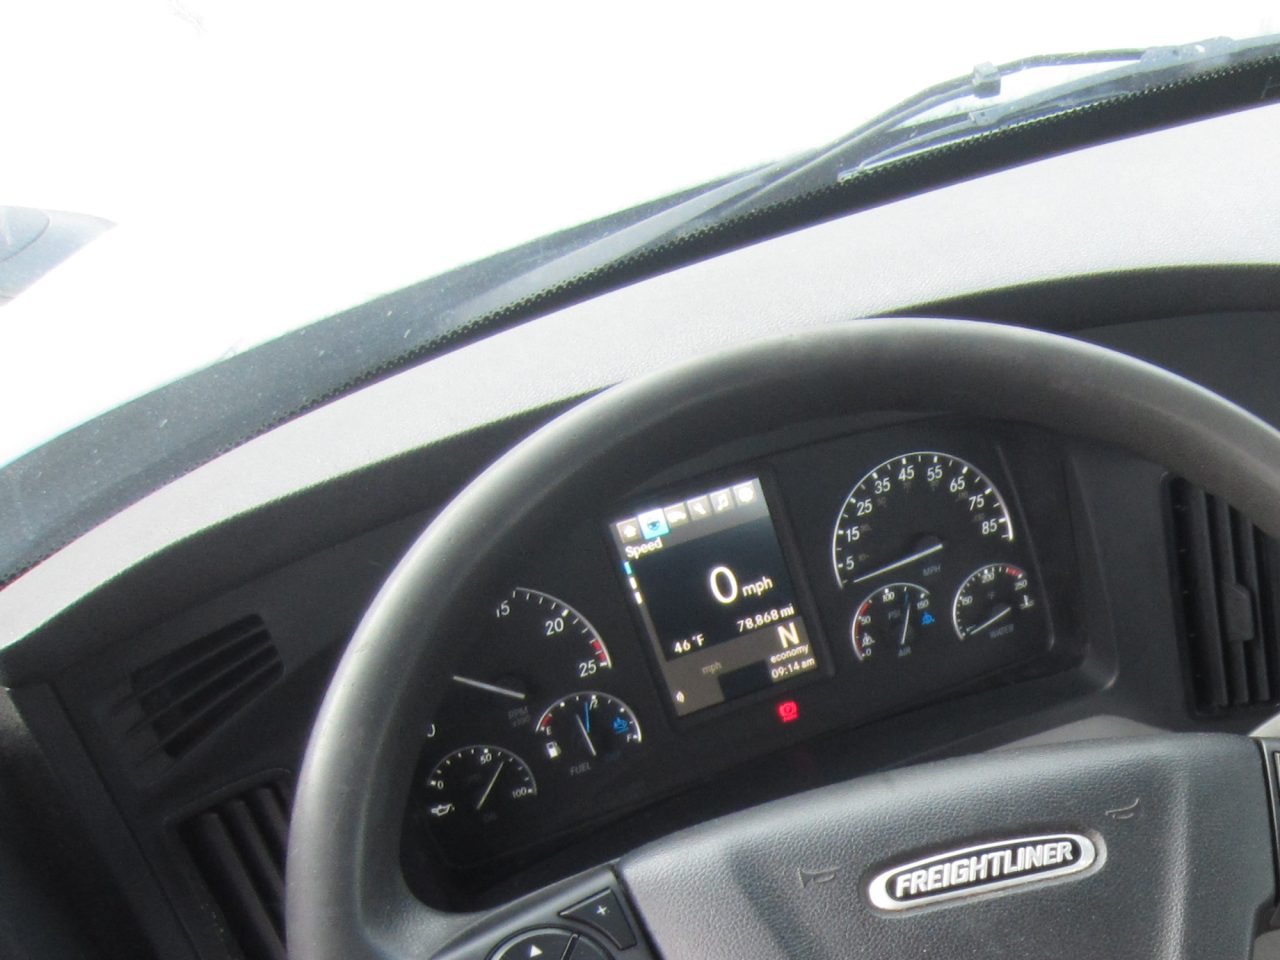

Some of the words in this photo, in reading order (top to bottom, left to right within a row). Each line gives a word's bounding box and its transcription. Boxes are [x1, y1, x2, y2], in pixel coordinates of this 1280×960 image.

[898, 465, 915, 482] 45
[927, 465, 943, 482] 55
[874, 478, 891, 495] 35
[949, 476, 966, 493] 65
[856, 498, 873, 517] 25
[968, 494, 985, 512] 75
[845, 526, 860, 543] 15
[981, 518, 998, 535] 85
[626, 540, 664, 560] Speed
[845, 556, 855, 571] 5
[709, 565, 738, 605] 0
[741, 575, 773, 598] mph
[981, 572, 995, 584] 200
[882, 591, 895, 603] 100
[916, 598, 930, 611] 150
[737, 609, 779, 632] 78,868
[780, 603, 795, 619] mi
[545, 617, 565, 636] 20
[778, 623, 800, 648] N
[673, 640, 692, 654] 46
[770, 645, 809, 663] economy
[579, 659, 597, 678] 25
[771, 662, 801, 679] 09:14
[800, 656, 816, 670] am
[546, 726, 552, 736] E
[480, 753, 492, 765] 50
[570, 762, 592, 776] FUEL
[437, 780, 444, 790] 0
[512, 787, 527, 799] 100
[895, 840, 1074, 898] FREIGHTLINER
